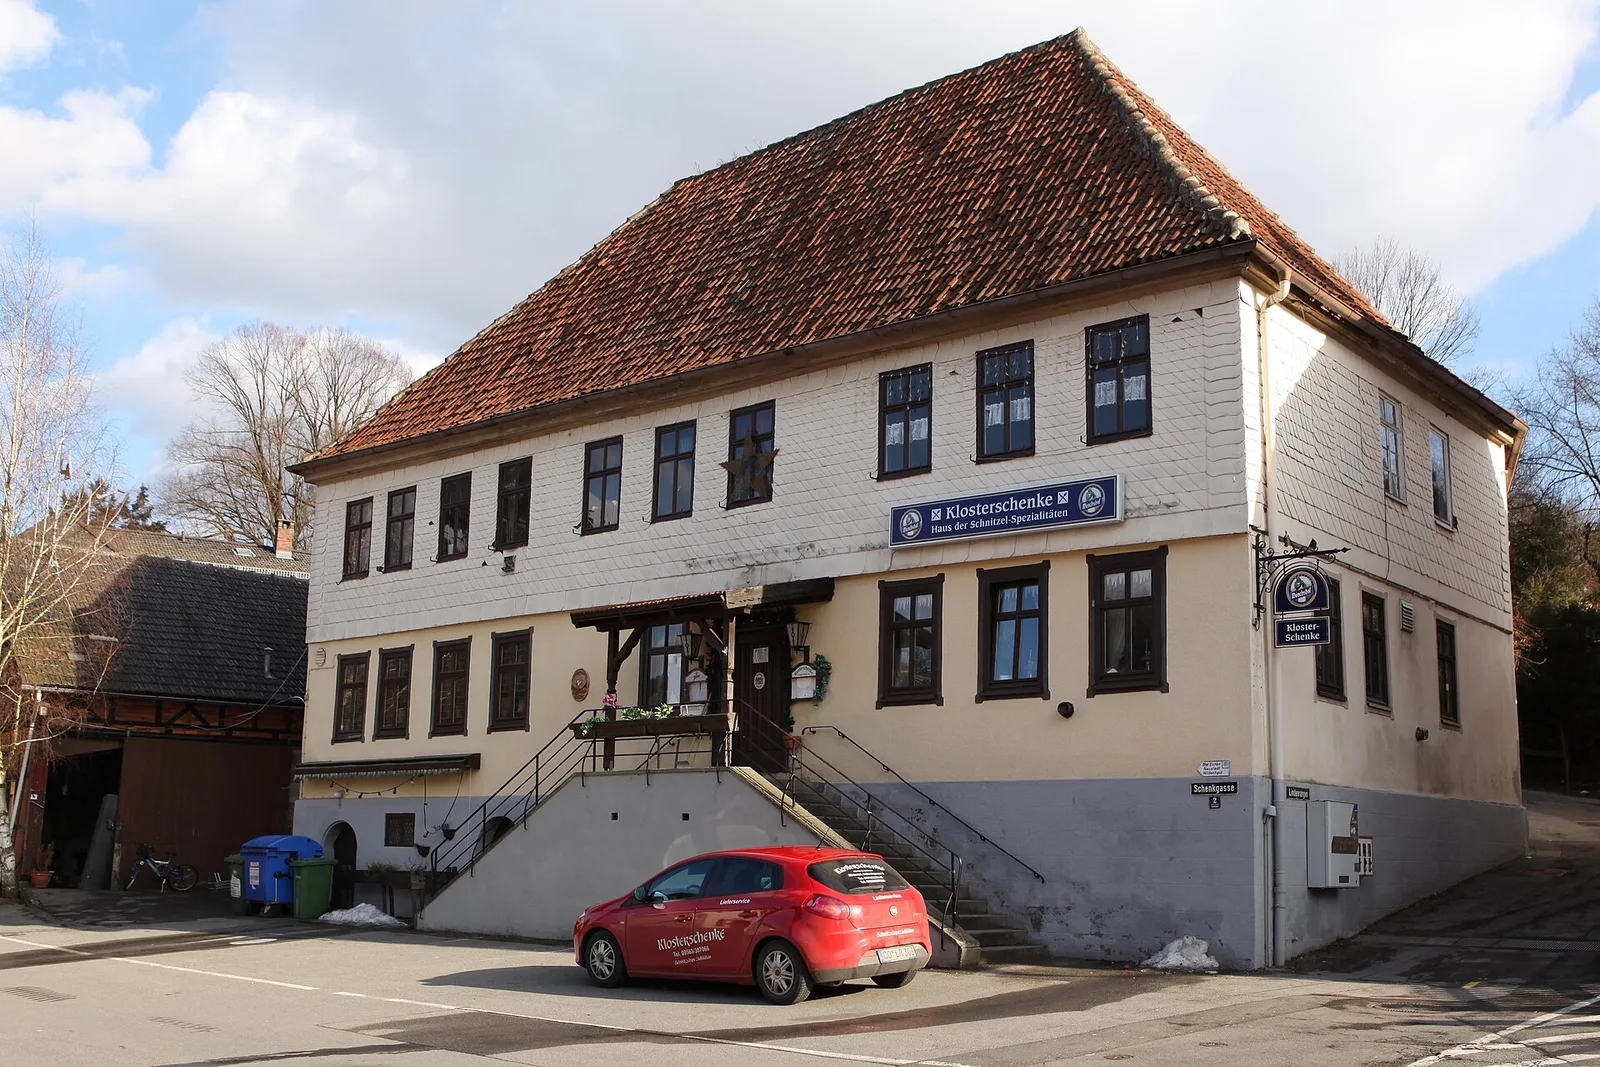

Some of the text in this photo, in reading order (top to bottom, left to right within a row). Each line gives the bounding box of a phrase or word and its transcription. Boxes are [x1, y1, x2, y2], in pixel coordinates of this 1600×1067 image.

[945, 493, 1053, 520] Klosterschenke
[931, 509, 1068, 534] Haus der Schnitzel-Spezialitäten
[1286, 623, 1320, 632] Kloster-
[1285, 632, 1320, 642] Schenke
[1193, 784, 1235, 794] Schenkgasse
[657, 928, 725, 951] Klosterschenke
